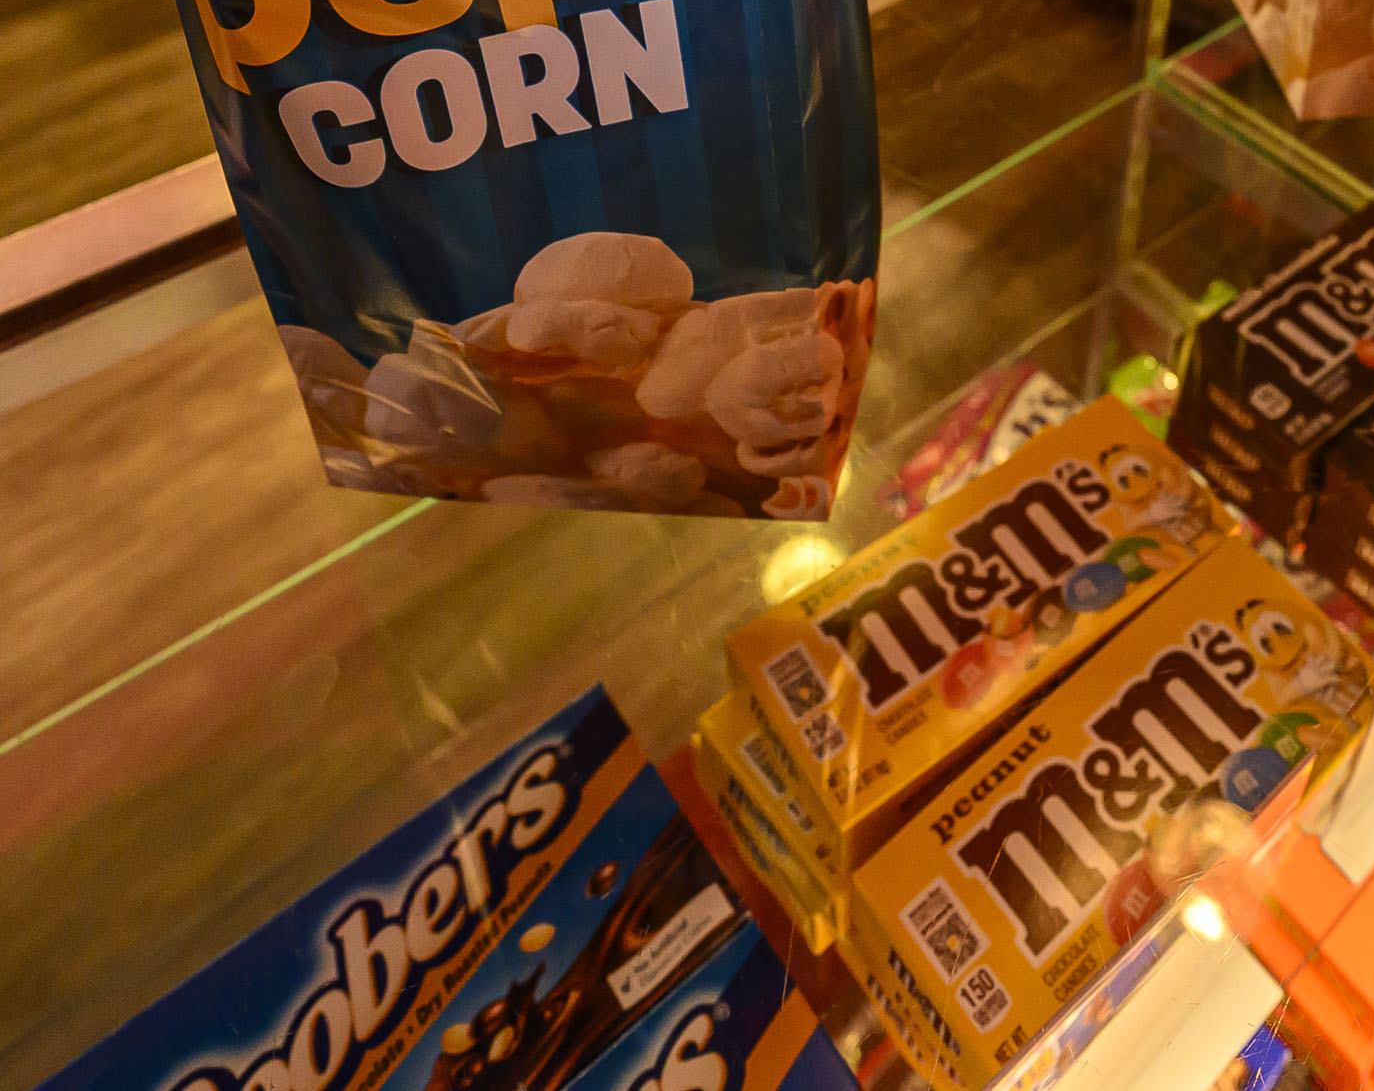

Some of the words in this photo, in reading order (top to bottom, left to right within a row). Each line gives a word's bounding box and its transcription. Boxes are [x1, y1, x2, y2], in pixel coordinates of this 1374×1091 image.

[930, 723, 1053, 846] peanut
[960, 967, 996, 1008] 150
[1041, 921, 1101, 988] CHOCOLATE
